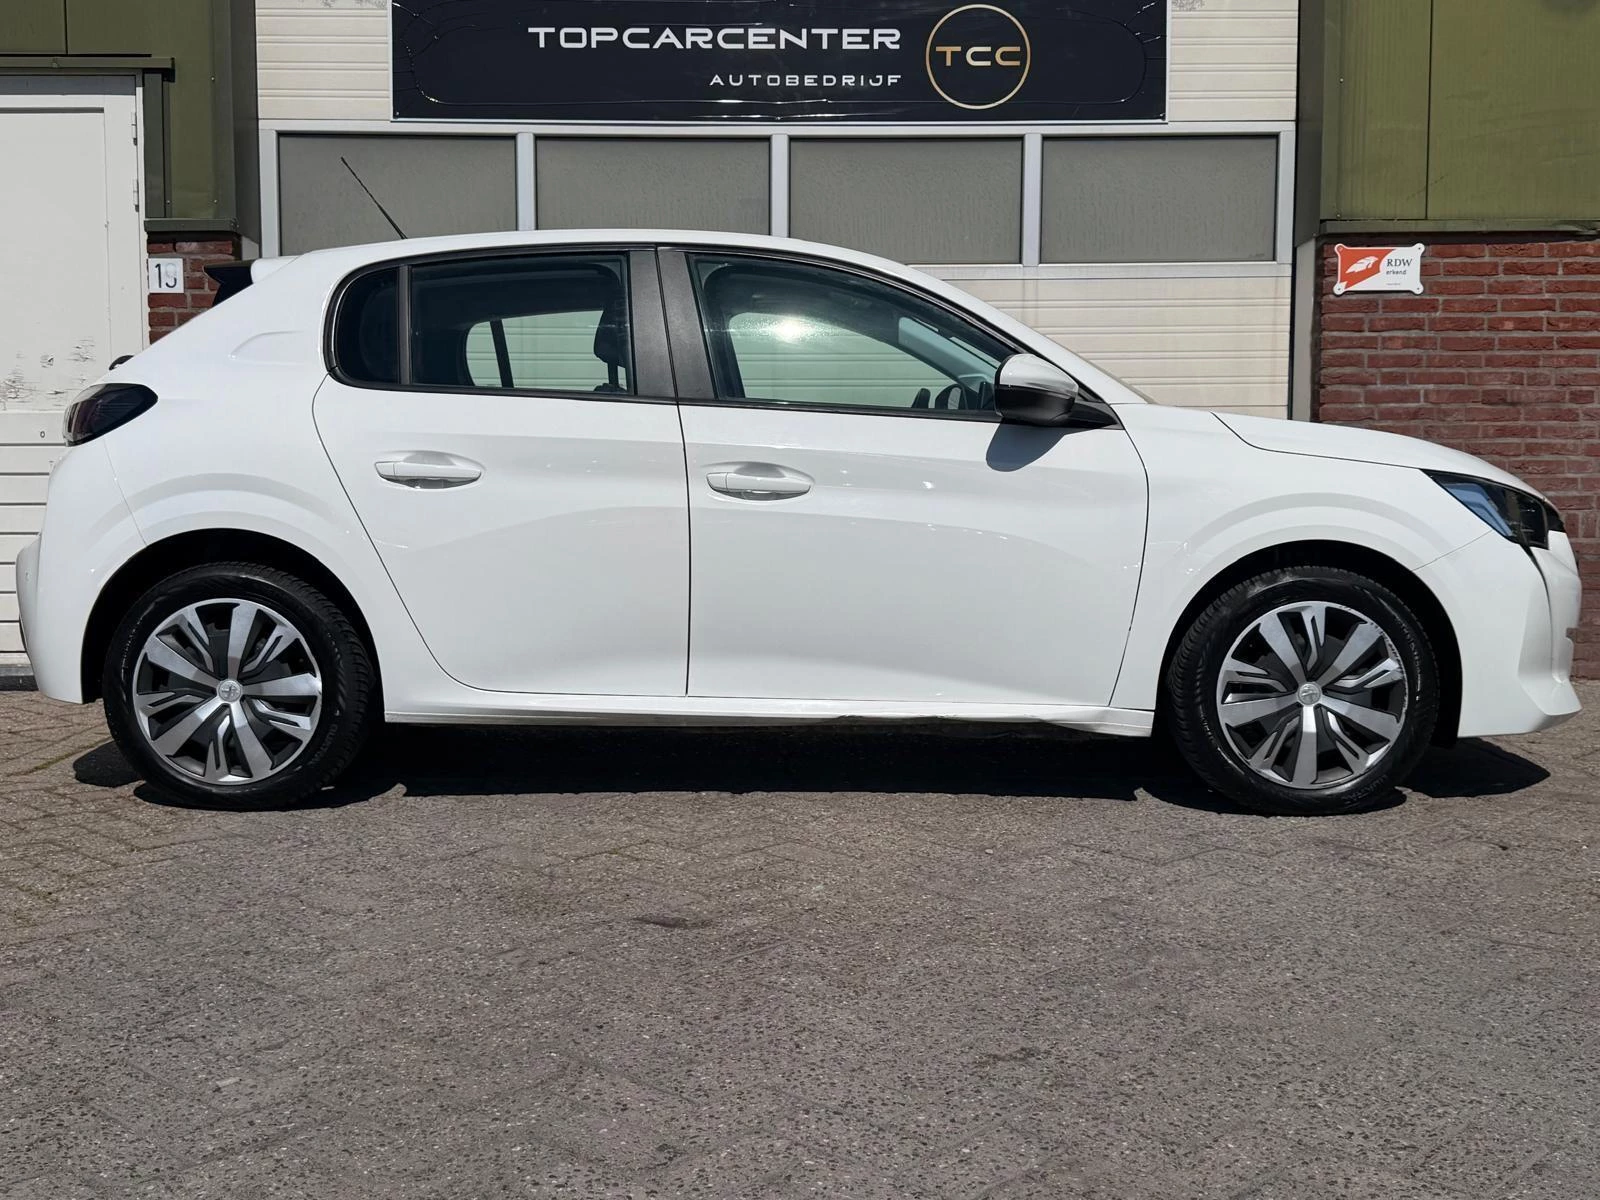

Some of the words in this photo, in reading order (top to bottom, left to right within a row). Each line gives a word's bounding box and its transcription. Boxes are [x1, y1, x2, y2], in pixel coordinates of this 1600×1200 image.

[528, 27, 901, 50] TOPCARCENTER
[935, 46, 1021, 67] TCC
[709, 74, 902, 87] AUTOBEDRIJF
[1386, 258, 1413, 268] RDW
